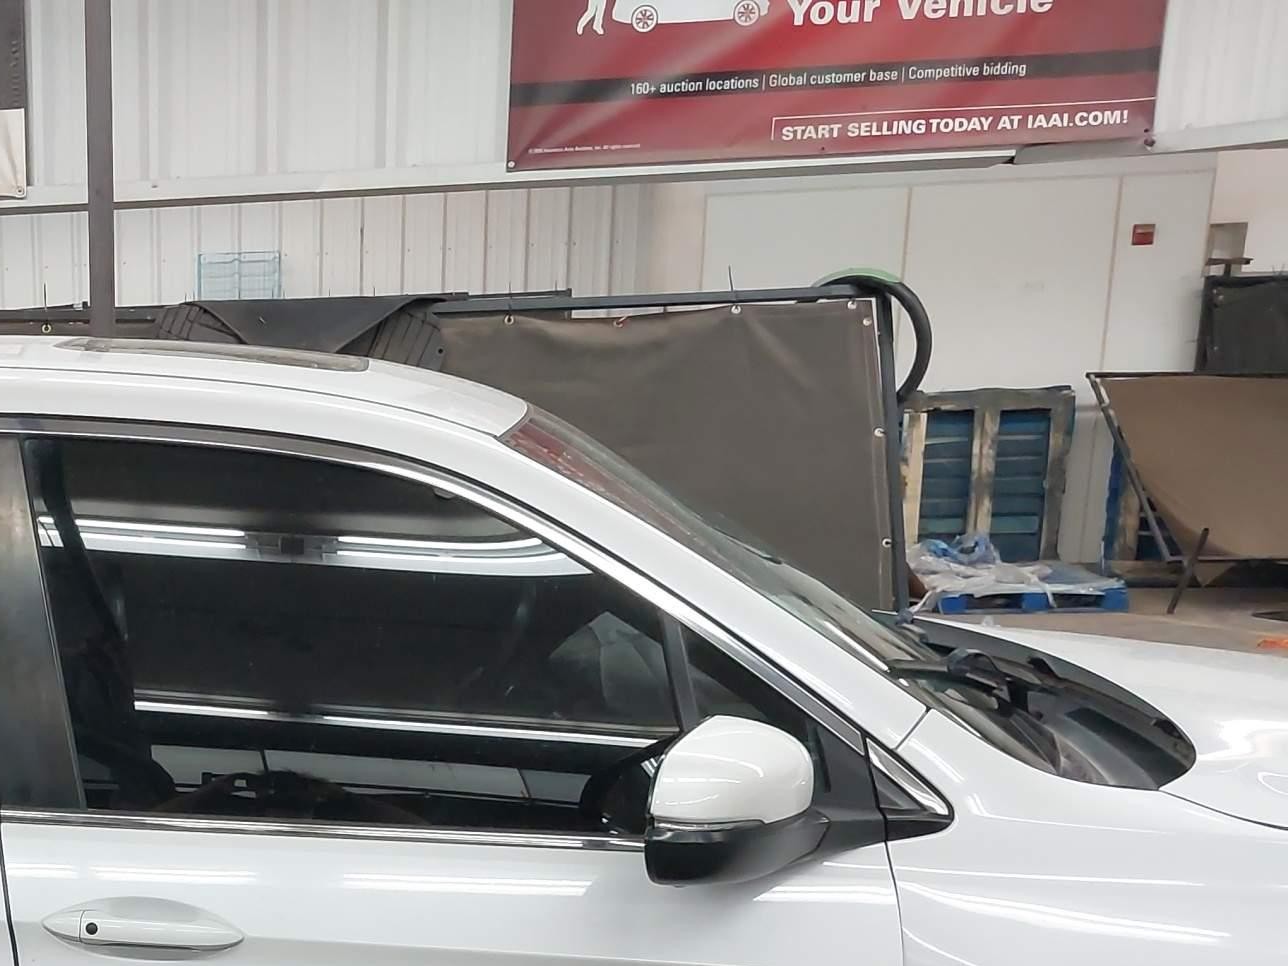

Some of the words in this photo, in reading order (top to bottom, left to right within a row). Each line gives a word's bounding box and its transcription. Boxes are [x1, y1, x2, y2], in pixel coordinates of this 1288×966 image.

[787, 0, 881, 26] Your
[630, 82, 656, 95] 160+
[659, 79, 703, 93] auction
[705, 76, 759, 91] locations
[769, 72, 807, 87] Global
[810, 70, 865, 85] customer
[869, 68, 898, 82] base
[908, 63, 979, 80] Competitive
[982, 61, 1027, 77] bidding
[782, 124, 842, 141] START
[846, 119, 926, 138] SELLING
[929, 116, 991, 134] TODAY
[996, 115, 1022, 130] AT
[1027, 110, 1129, 129] IAAI.COM!
